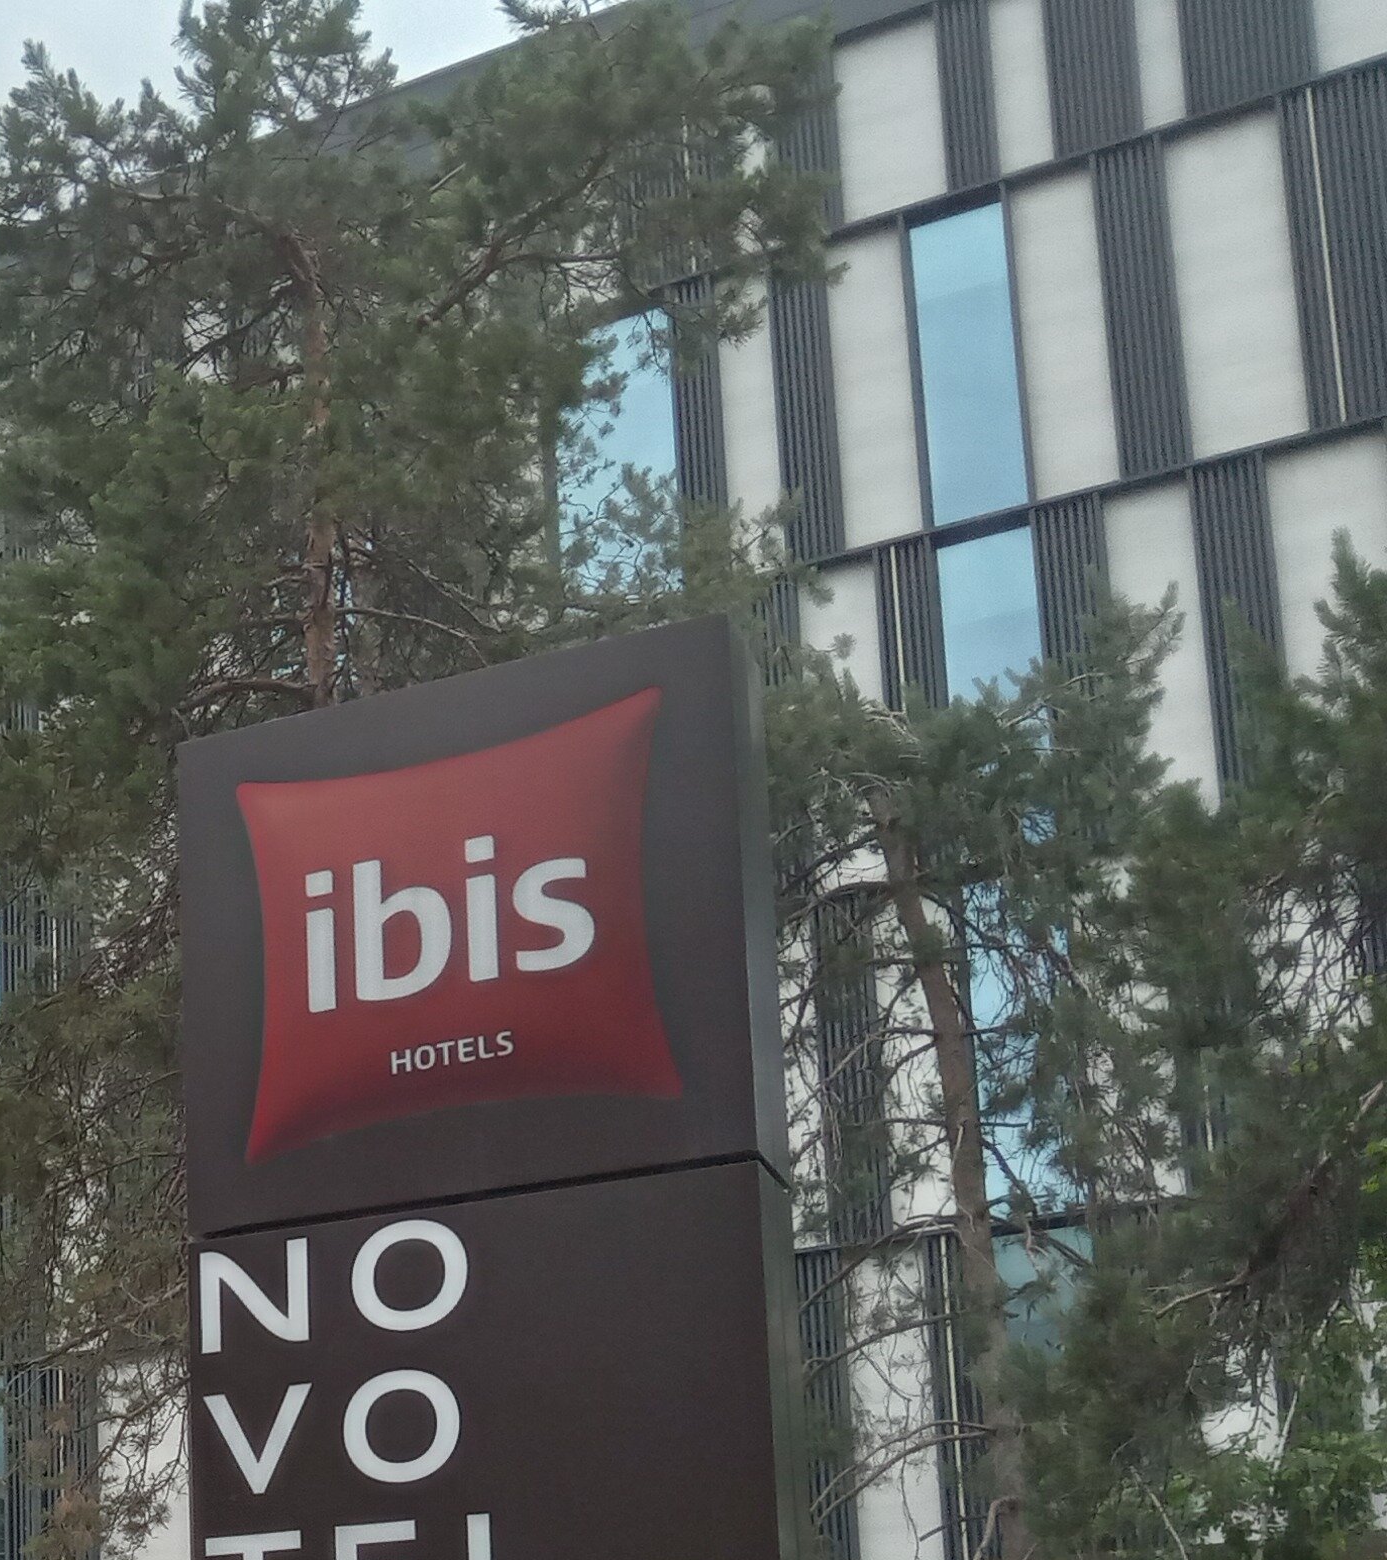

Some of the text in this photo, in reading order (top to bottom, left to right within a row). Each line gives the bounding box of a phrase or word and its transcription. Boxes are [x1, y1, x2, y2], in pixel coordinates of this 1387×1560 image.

[305, 835, 595, 1013] ibis
[390, 1031, 514, 1076] HOTELS
[199, 1219, 468, 1354] NO
[203, 1369, 460, 1495] VO
